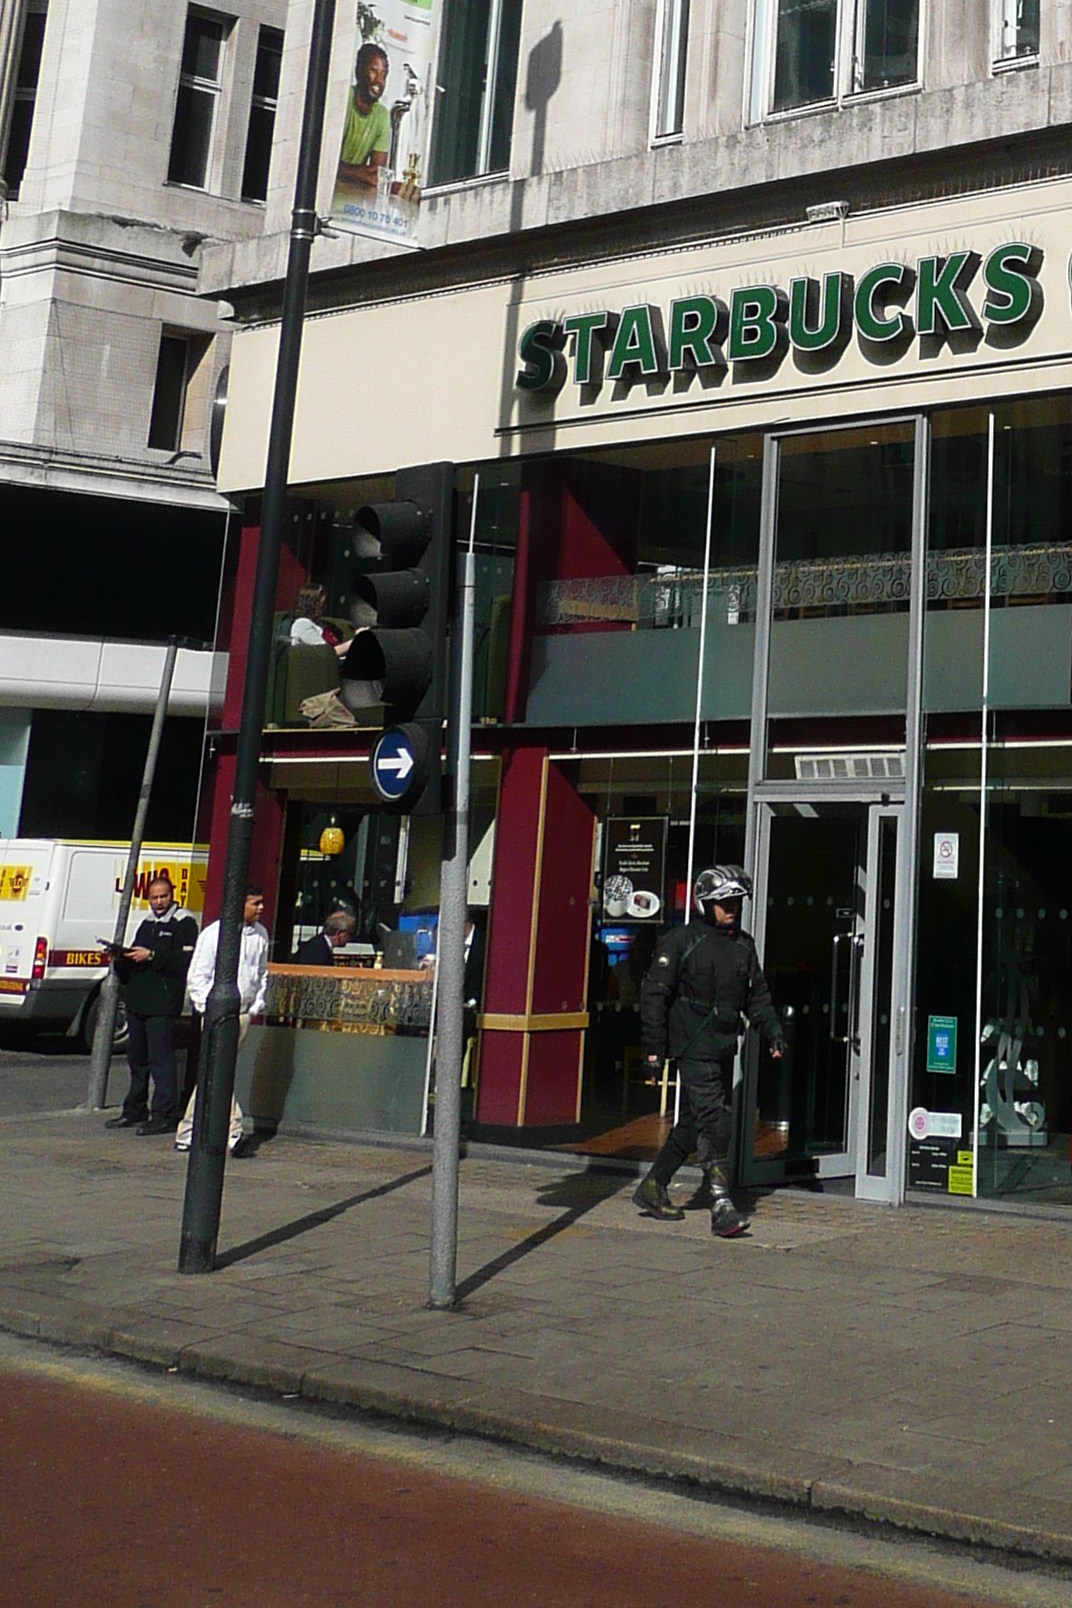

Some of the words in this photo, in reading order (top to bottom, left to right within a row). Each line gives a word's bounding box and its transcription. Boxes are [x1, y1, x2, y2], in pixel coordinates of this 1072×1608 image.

[343, 204, 365, 218] 0800
[515, 242, 1042, 391] STARBUCKS
[66, 952, 102, 965] BIKES
